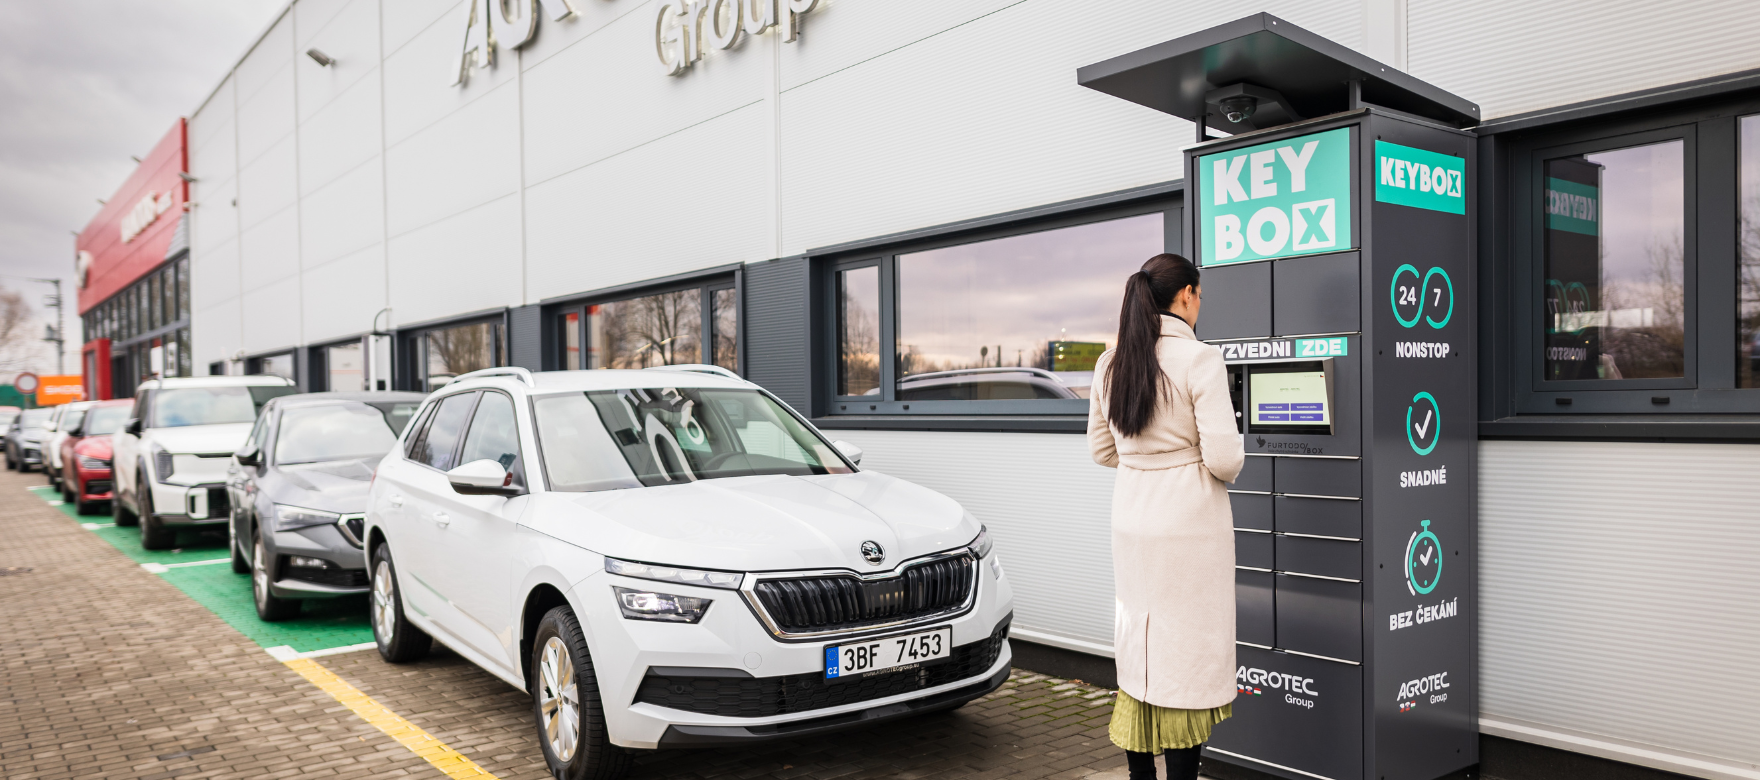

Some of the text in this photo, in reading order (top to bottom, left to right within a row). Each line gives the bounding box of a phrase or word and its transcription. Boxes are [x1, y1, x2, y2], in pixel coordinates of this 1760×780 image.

[1213, 140, 1320, 206] KEY
[1380, 156, 1462, 198] KEYBOX
[1214, 198, 1336, 261] BOX
[1399, 286, 1441, 307] 24 7
[1211, 339, 1342, 359] YZVEDNI ZDE
[1395, 341, 1450, 359] NONSTOP
[1400, 465, 1447, 488] SNADNÉ
[1389, 597, 1458, 631] BEZ ČEKÁNÍ
[844, 633, 942, 672] 3BF 7453
[827, 666, 838, 675] CZ
[1235, 665, 1319, 697] AGROTEC
[1396, 671, 1450, 702] AGROTEC
[1430, 692, 1448, 705] Group
[1285, 693, 1314, 710] Group
